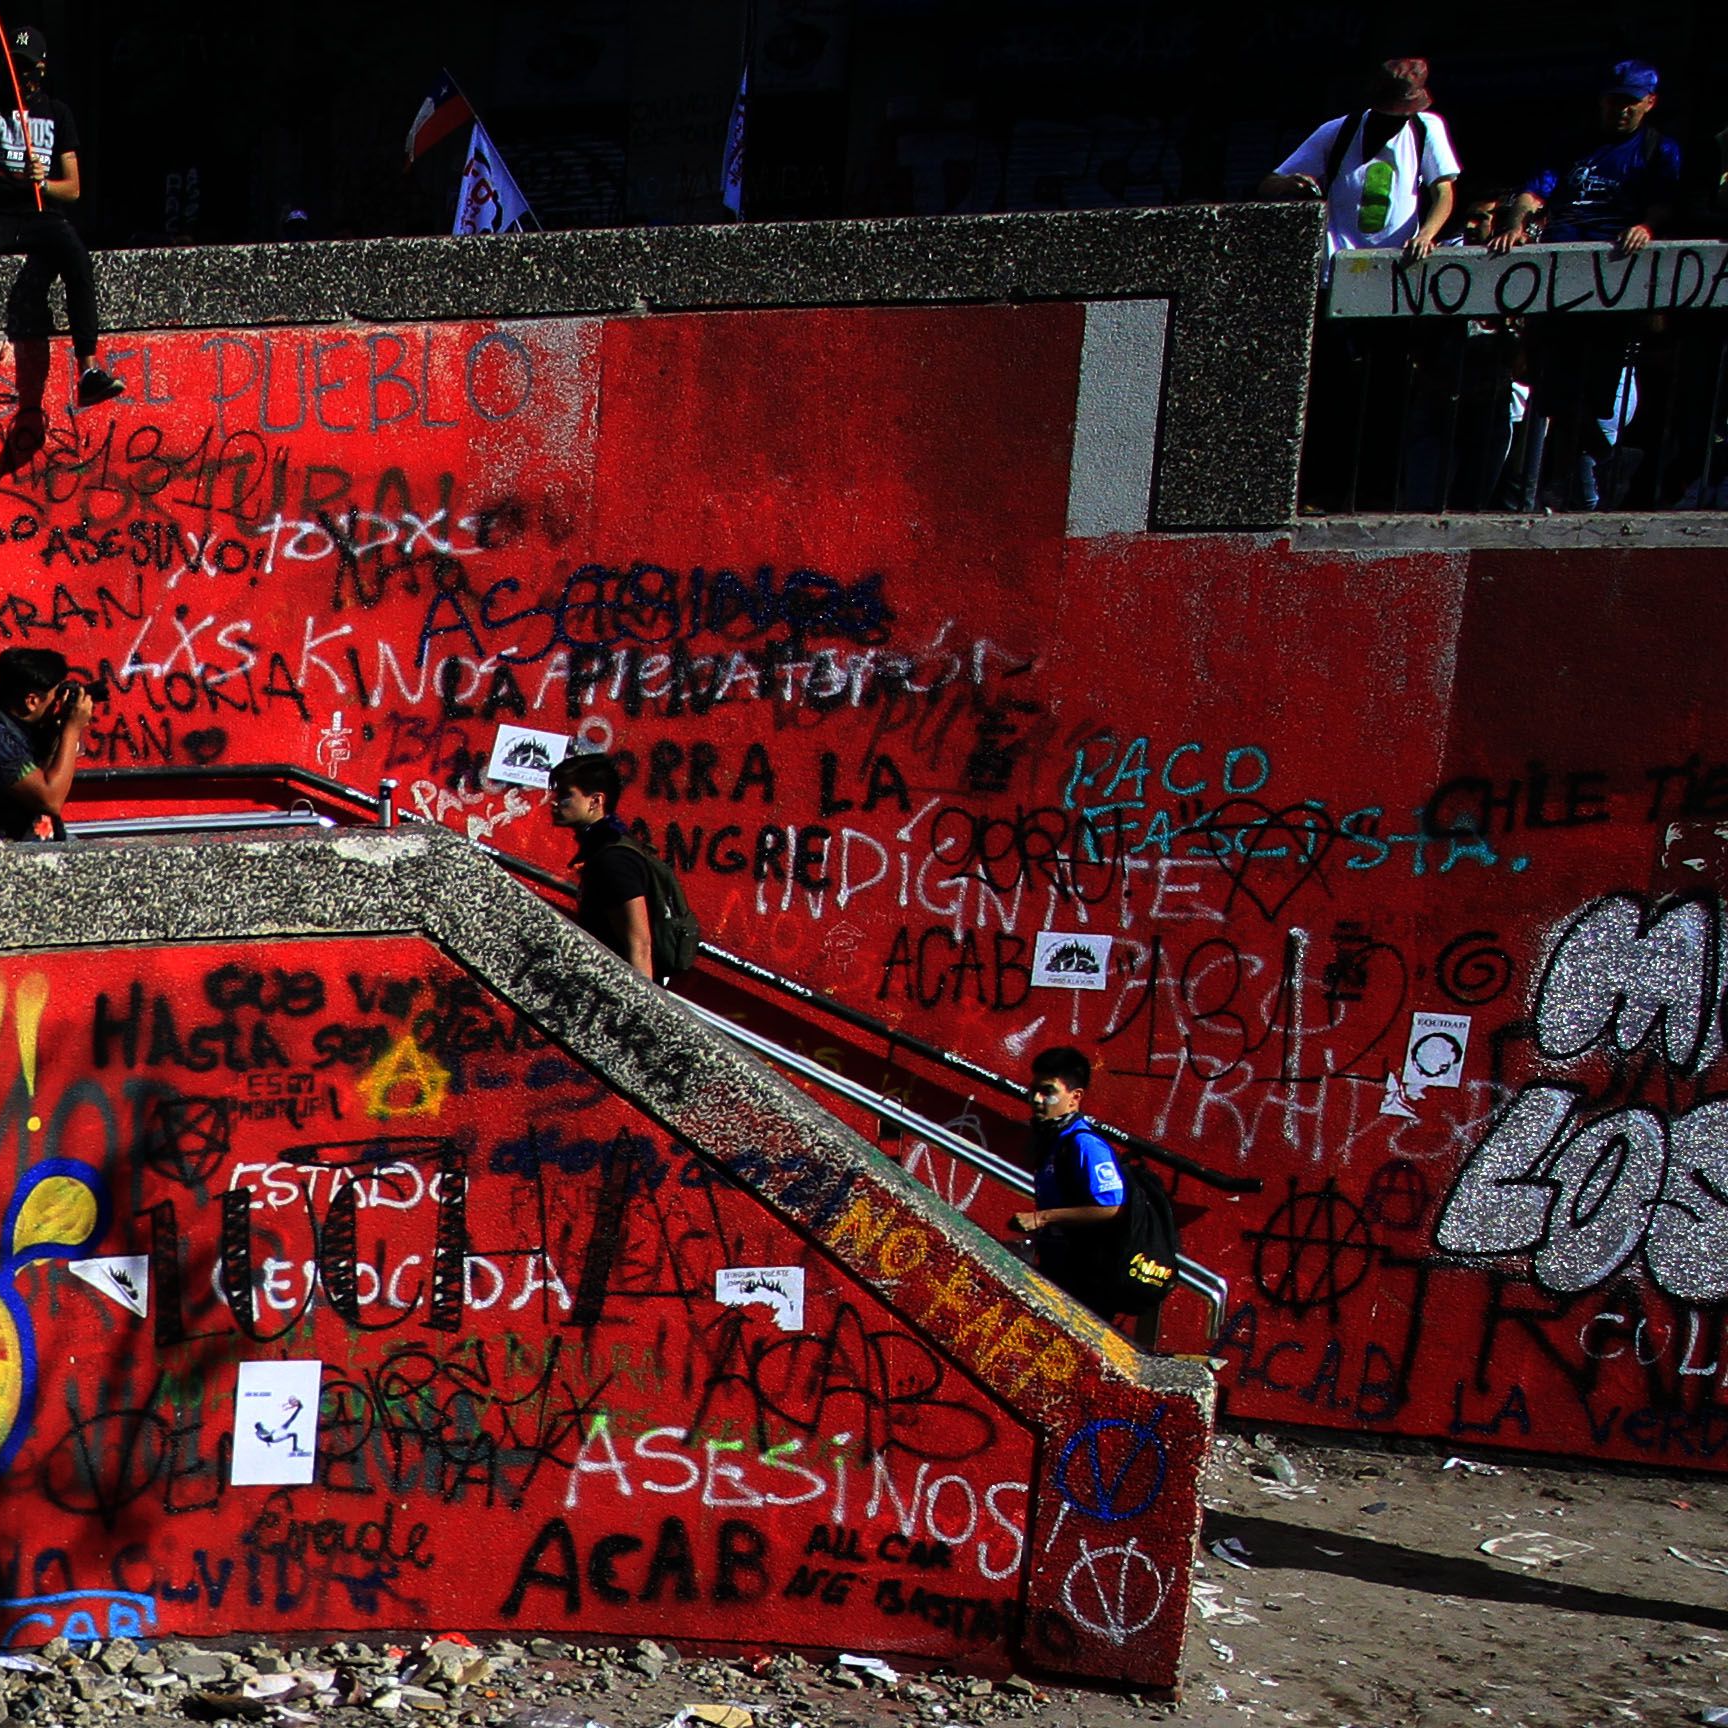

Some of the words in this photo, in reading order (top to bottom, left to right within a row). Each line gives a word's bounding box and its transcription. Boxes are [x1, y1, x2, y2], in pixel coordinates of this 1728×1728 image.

[1392, 259, 1471, 315] NO
[200, 328, 536, 440] PUEBLO
[1063, 736, 1272, 808] PACO
[882, 924, 1032, 1011] ACAB
[1415, 1015, 1470, 1031] EQUIDAD
[227, 1160, 470, 1214] ESTADO
[832, 1196, 930, 1282] NO
[499, 1515, 773, 1617] ACAB
